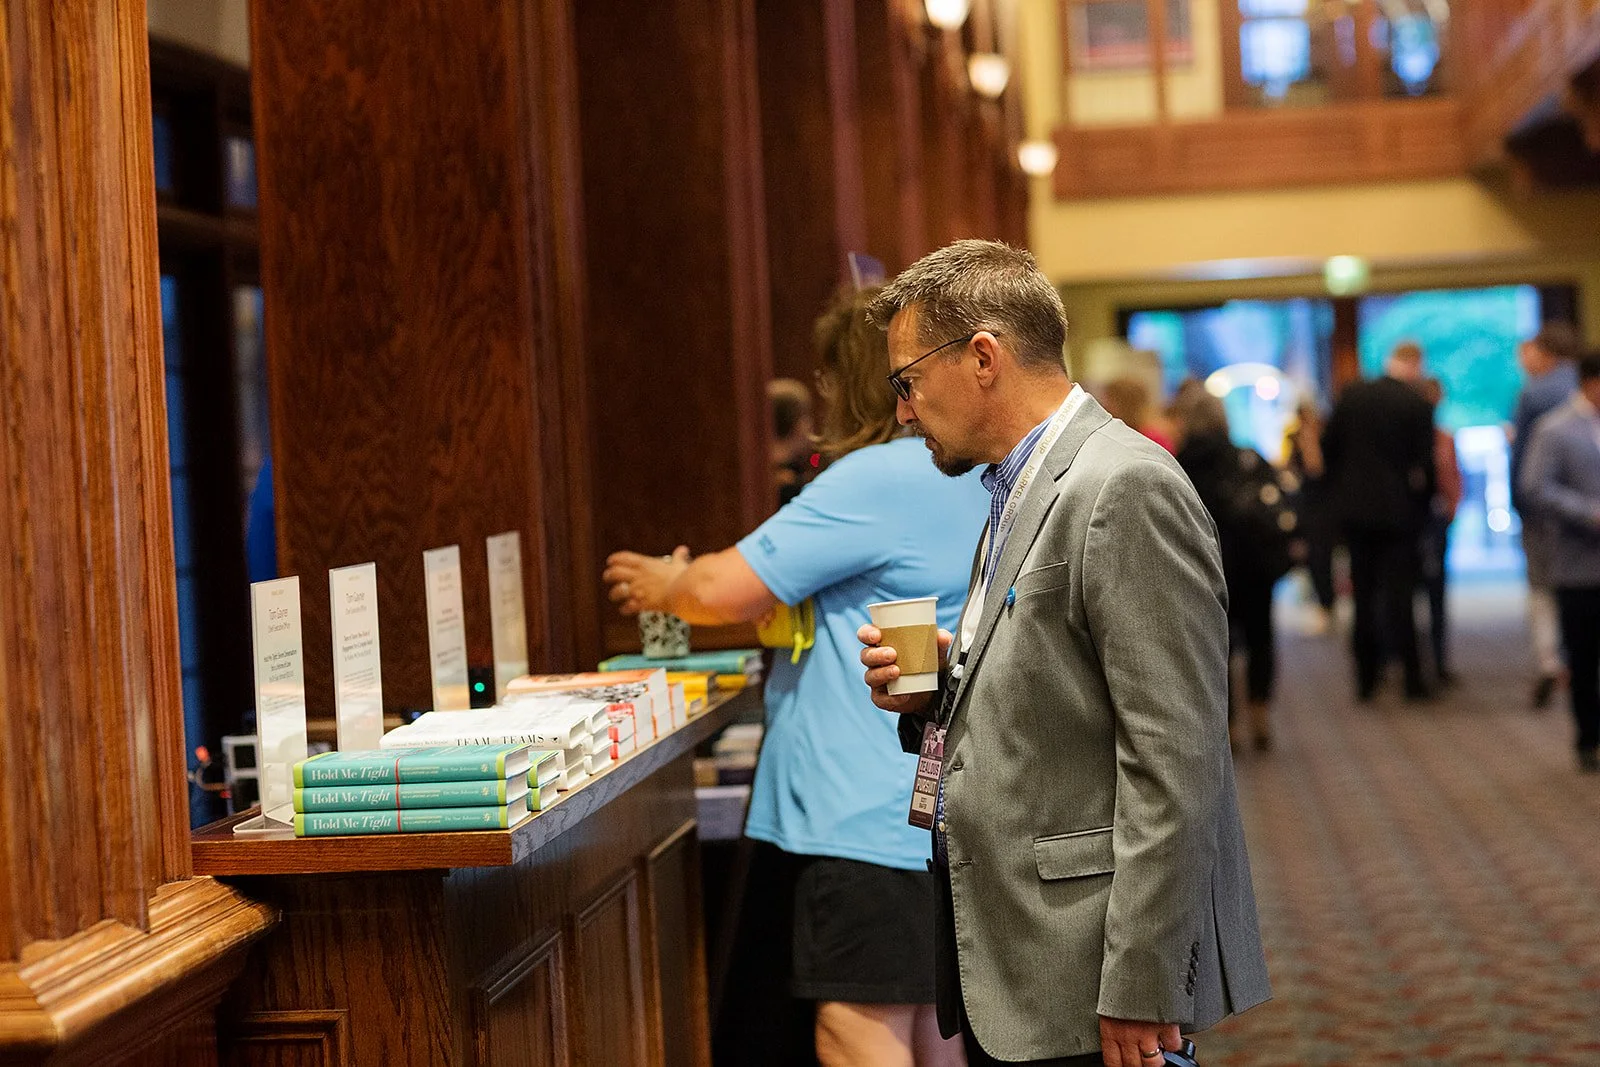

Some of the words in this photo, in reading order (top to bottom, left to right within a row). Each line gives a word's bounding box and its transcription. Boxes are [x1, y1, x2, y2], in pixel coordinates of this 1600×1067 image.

[1039, 425, 1060, 455] GROUP
[1012, 464, 1035, 501] MARKEL
[1000, 501, 1017, 533] GROUP
[456, 737, 490, 746] TEAM
[502, 734, 545, 745] TEAMS
[312, 768, 338, 780] Hold
[341, 768, 358, 779] Me
[360, 765, 390, 781] Tight
[312, 791, 338, 804] Hold
[341, 791, 358, 803] Me
[360, 789, 390, 805] Tight
[313, 818, 340, 830] Hold
[343, 817, 359, 829] Me
[362, 815, 392, 831] Tight
